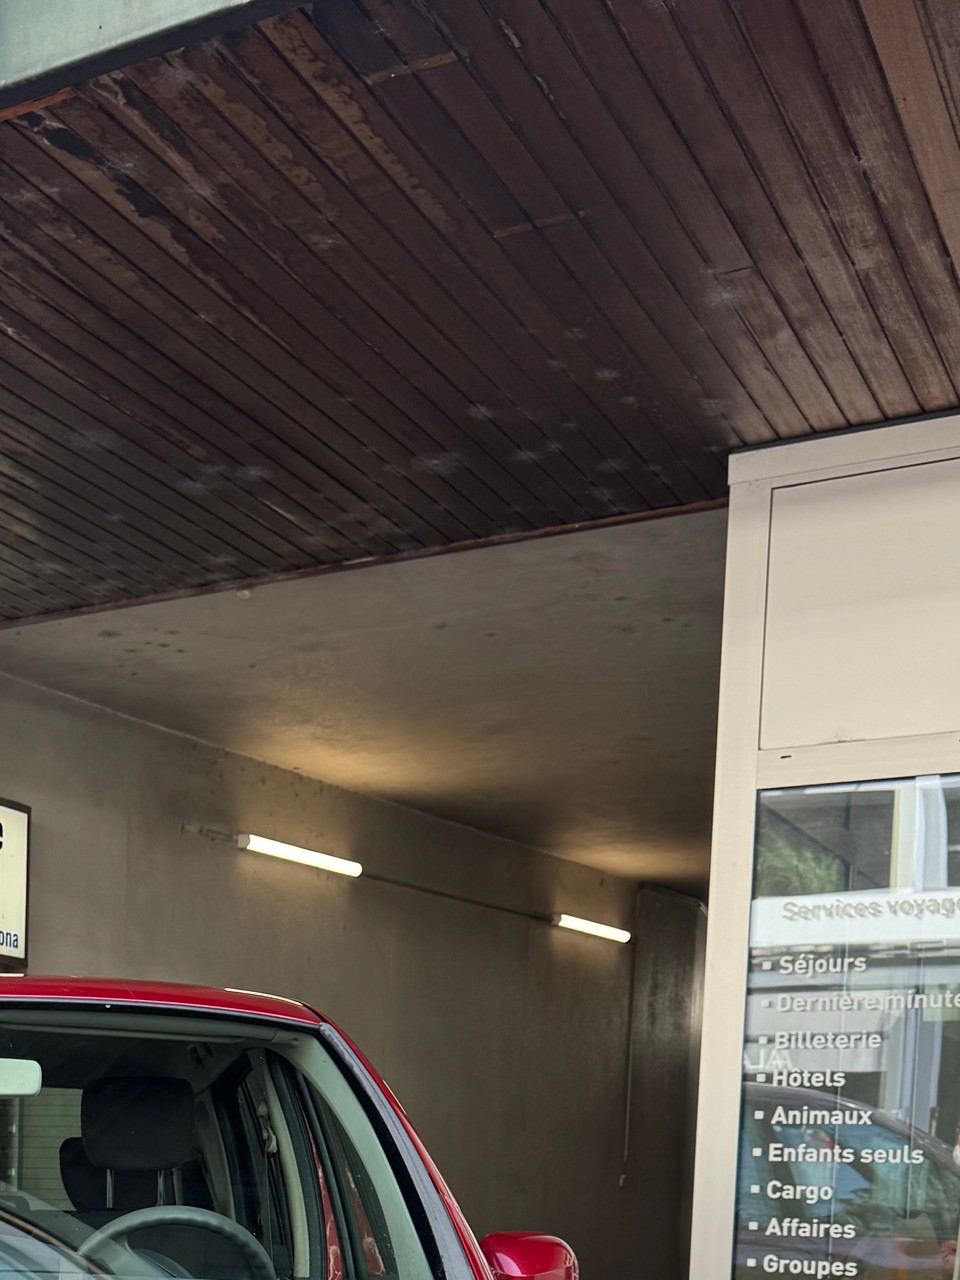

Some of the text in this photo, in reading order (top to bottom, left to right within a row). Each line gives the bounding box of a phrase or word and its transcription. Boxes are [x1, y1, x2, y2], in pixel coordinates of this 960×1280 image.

[782, 899, 883, 921] Services
[779, 953, 867, 978] Séjours
[776, 991, 881, 1012] Dernière
[775, 1031, 882, 1049] Billeterie
[772, 1067, 846, 1087] Hôtels
[770, 1105, 873, 1125] Animaux
[768, 1143, 924, 1164] Enfants seuls
[766, 1180, 833, 1204] Cargo
[764, 1217, 856, 1239] Affaires
[762, 1254, 858, 1279] Groupes
